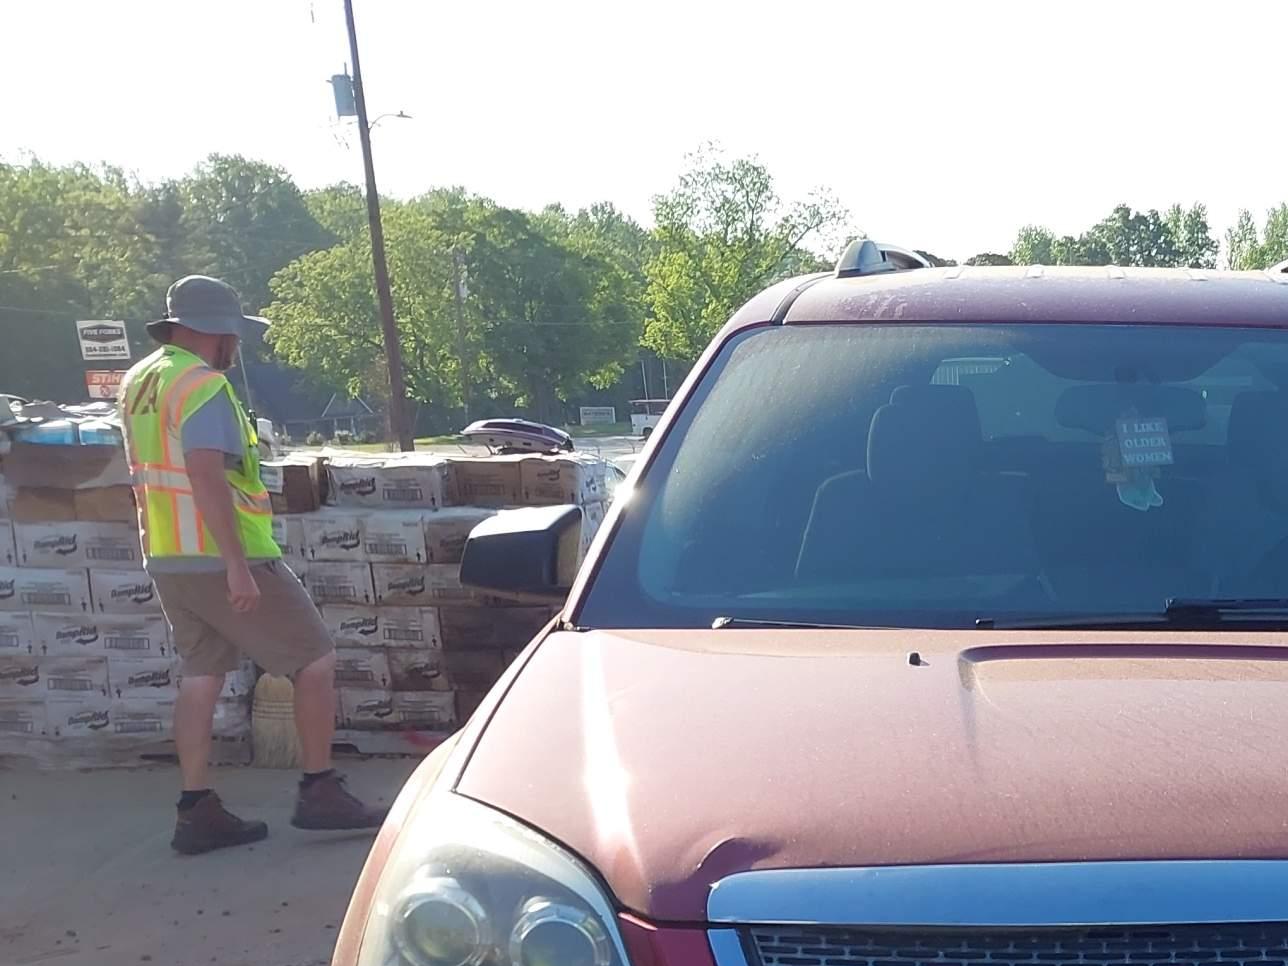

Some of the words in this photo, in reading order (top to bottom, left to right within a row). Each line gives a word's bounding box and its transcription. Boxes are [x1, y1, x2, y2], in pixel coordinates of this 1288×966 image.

[1133, 422, 1164, 433] LIKE
[1124, 437, 1167, 449] OLDER
[1122, 451, 1172, 464] WOMEN
